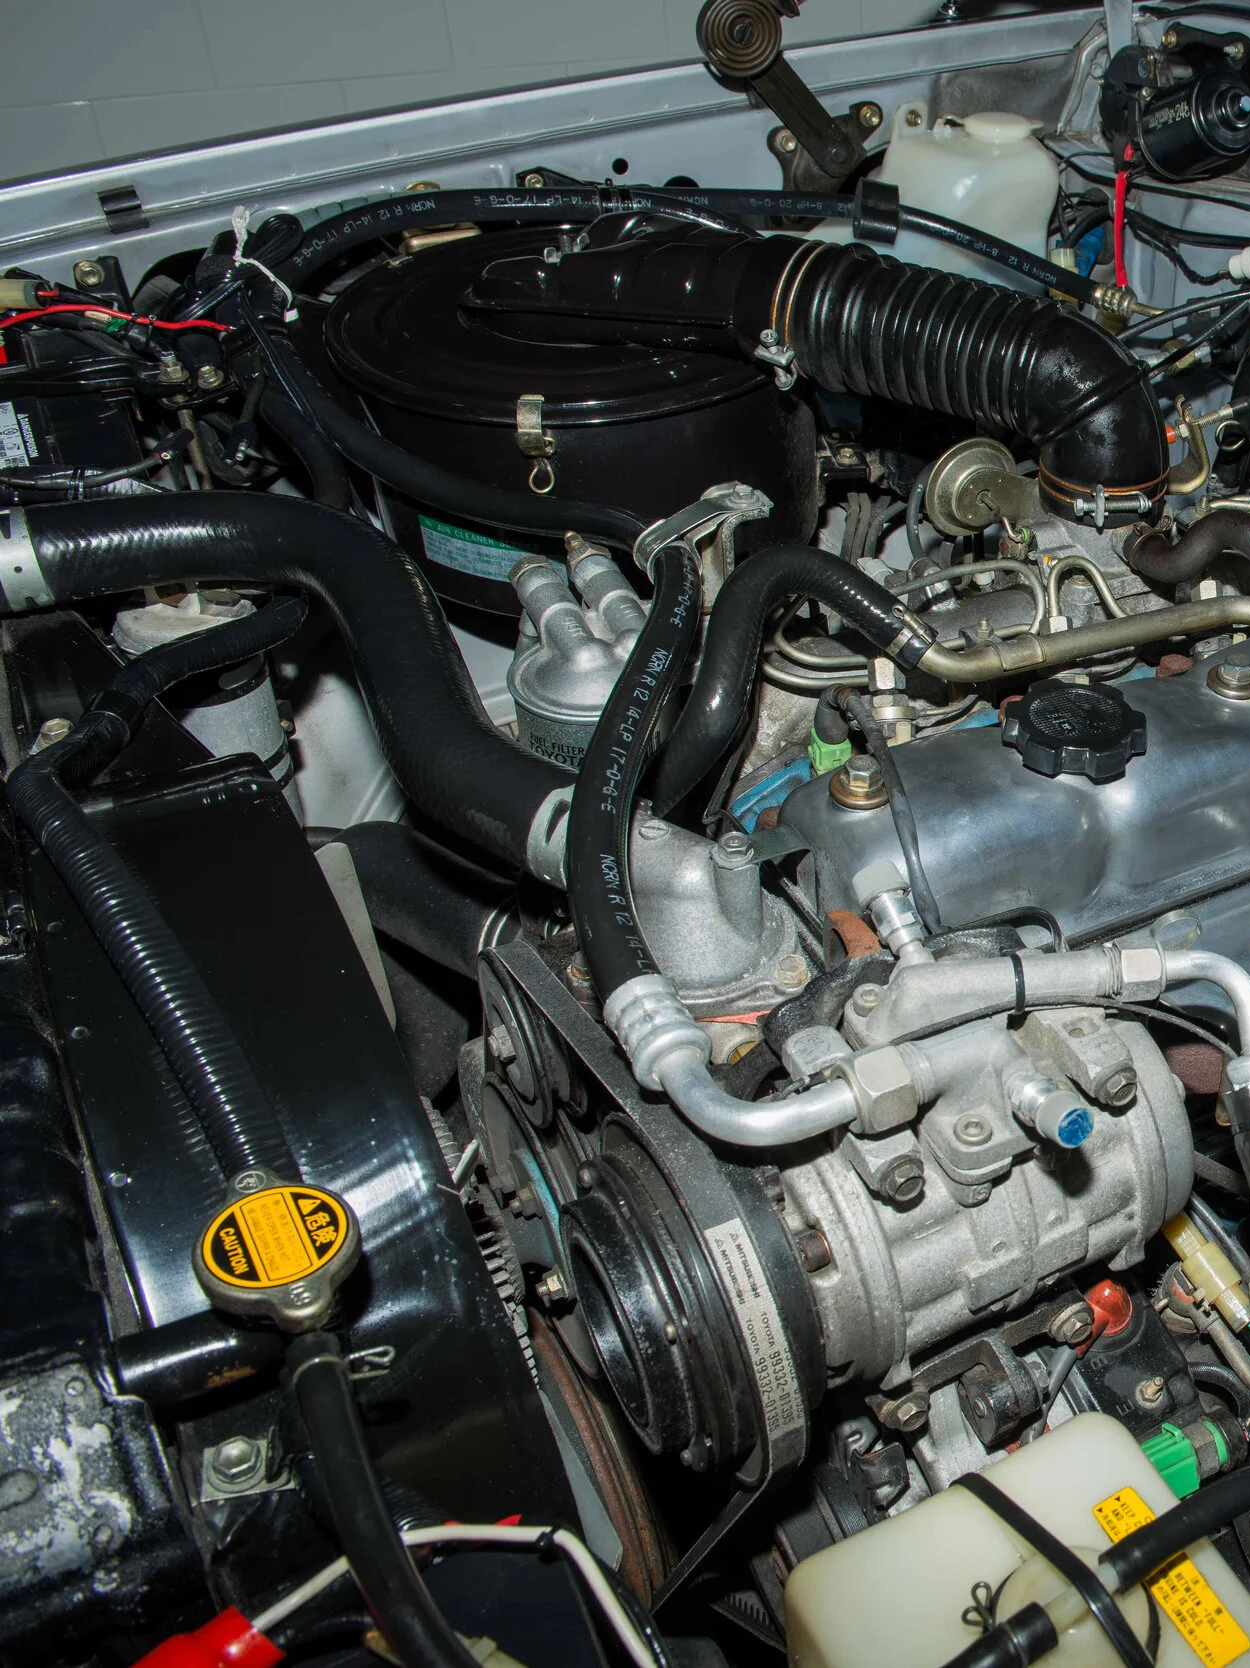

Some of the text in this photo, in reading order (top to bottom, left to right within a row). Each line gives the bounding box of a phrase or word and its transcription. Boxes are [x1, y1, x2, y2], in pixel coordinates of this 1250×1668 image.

[437, 524, 450, 534] AIR
[530, 732, 585, 756] FUEL FILTER
[219, 1227, 249, 1276] CAUTION
[746, 1318, 761, 1355] TOYOTA
[760, 1311, 775, 1348] TOYOTA
[769, 1350, 795, 1426] 99332-01395
[1111, 1508, 1123, 1522] AND
[1120, 1502, 1136, 1519] KEEP
[1174, 1571, 1202, 1607] BETWEEN
[1177, 1596, 1187, 1606] IS
